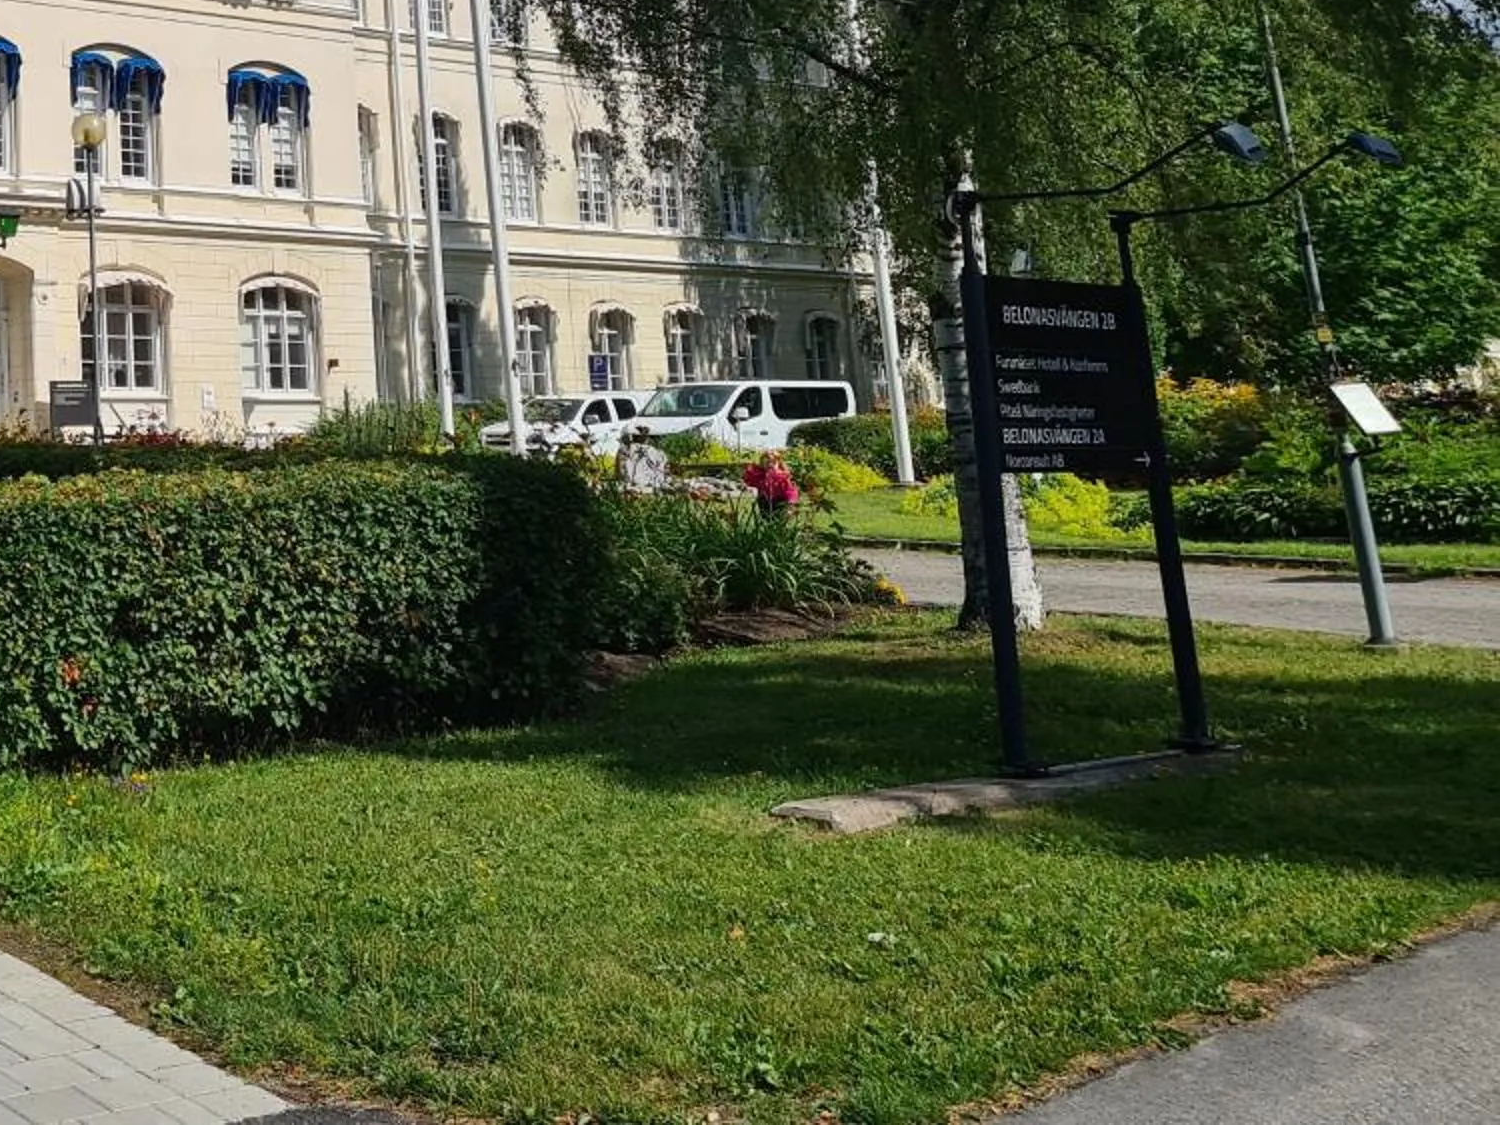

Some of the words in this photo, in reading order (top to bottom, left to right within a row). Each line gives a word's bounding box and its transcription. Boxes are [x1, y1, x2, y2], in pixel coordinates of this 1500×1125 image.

[1101, 312, 1116, 330] 2B
[593, 357, 603, 371] P
[997, 378, 1041, 394] Swedbank
[1092, 428, 1106, 444] 2A
